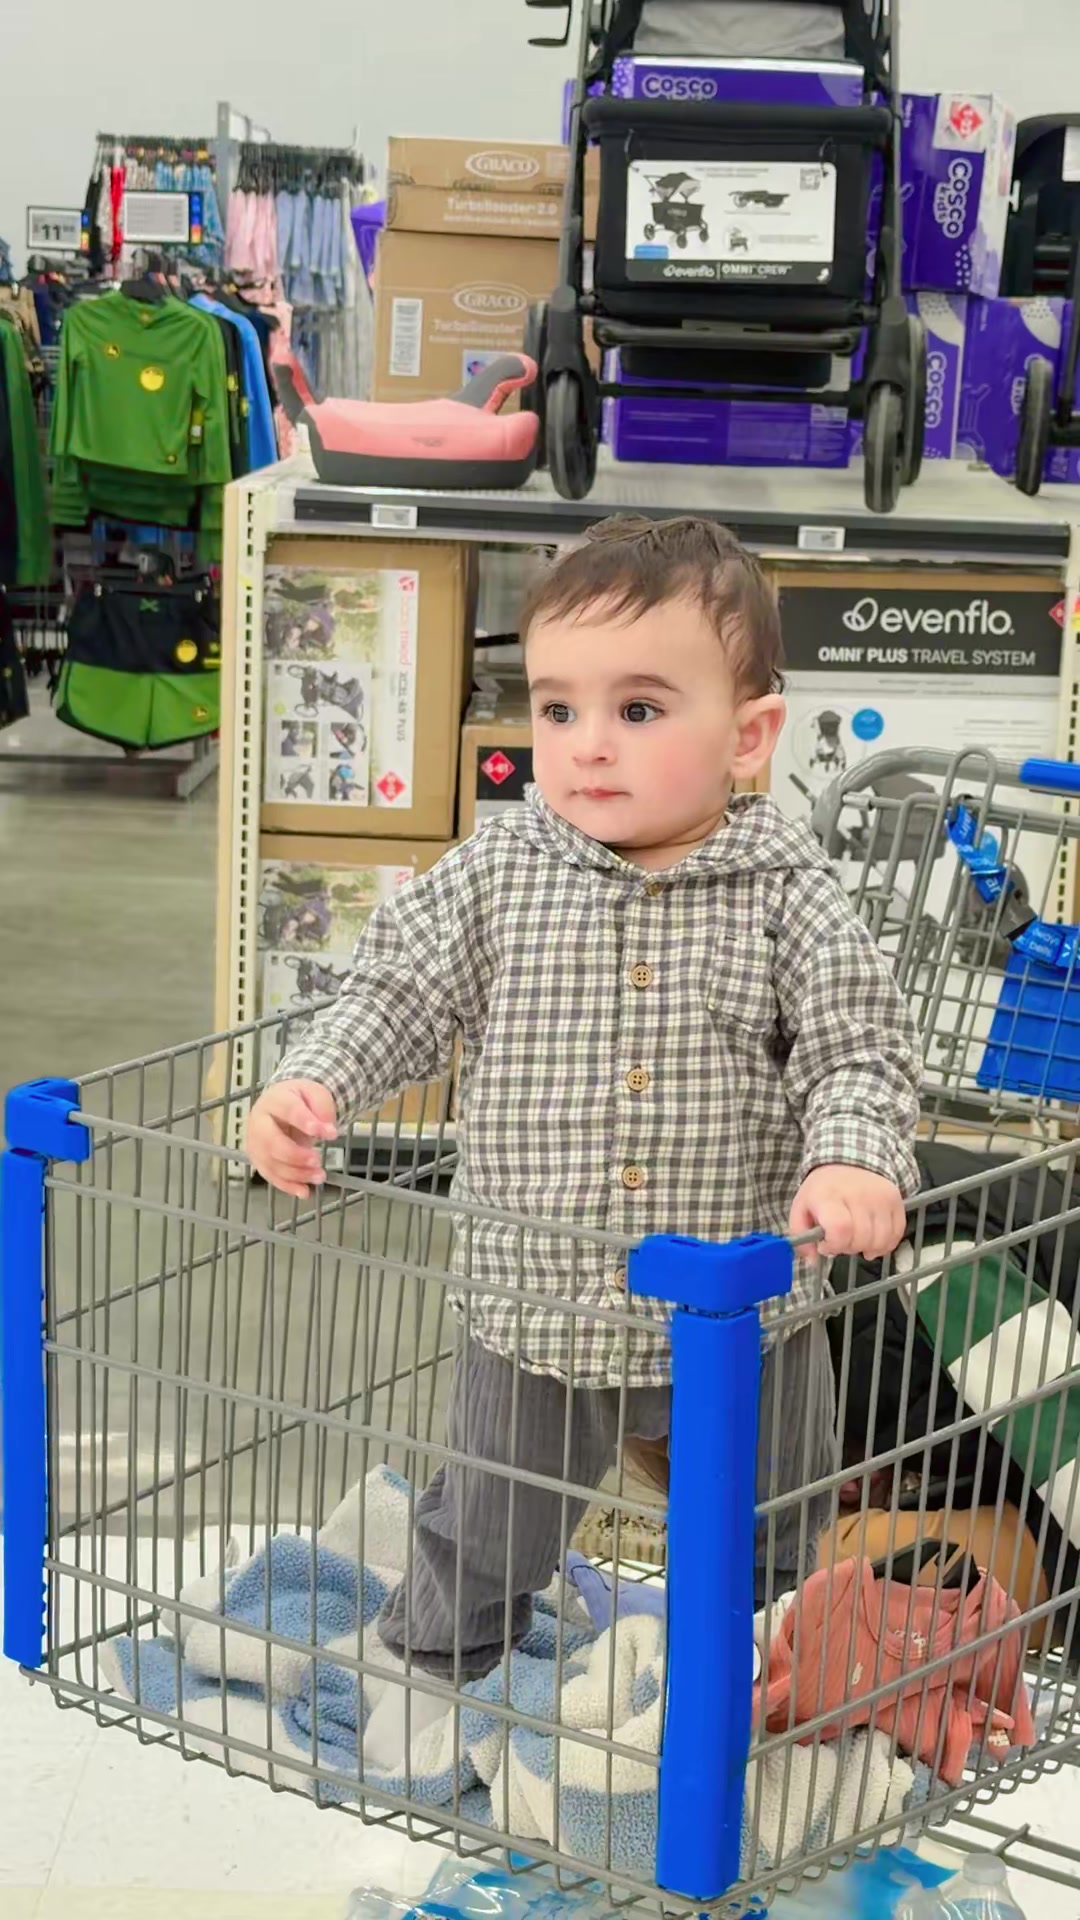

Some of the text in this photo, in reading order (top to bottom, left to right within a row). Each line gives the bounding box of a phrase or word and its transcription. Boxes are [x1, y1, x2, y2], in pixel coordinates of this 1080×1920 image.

[475, 157, 532, 173] GRACO
[463, 292, 521, 309] GRACO
[866, 647, 909, 664] PLUS
[911, 648, 969, 666] TRAVEL
[971, 649, 1037, 667] SYSTEM
